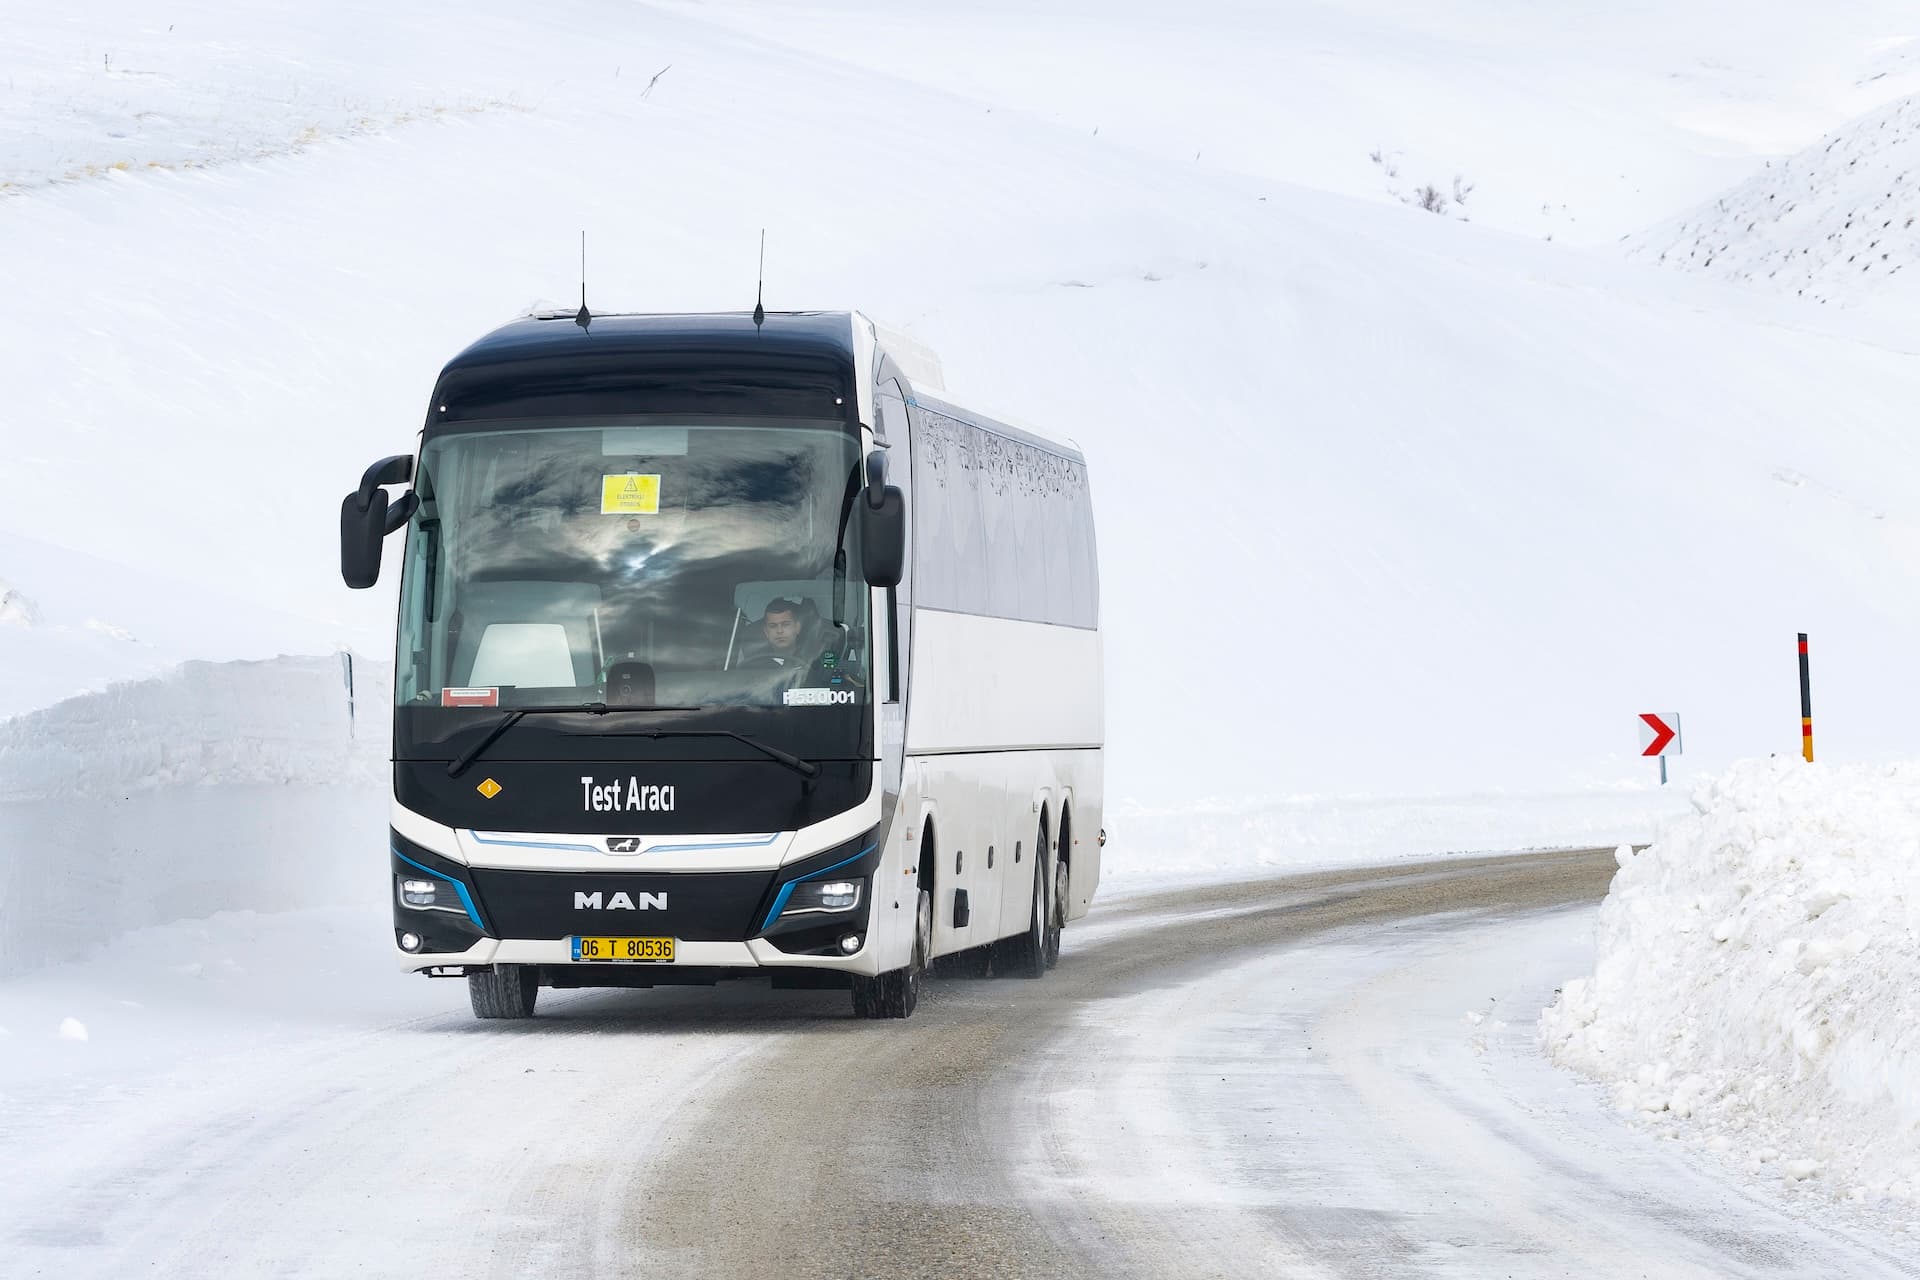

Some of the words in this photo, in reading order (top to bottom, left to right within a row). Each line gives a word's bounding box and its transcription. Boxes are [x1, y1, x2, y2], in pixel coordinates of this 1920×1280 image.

[581, 776, 621, 811] Test
[625, 776, 675, 811] Aracı
[574, 891, 668, 910] MAN
[581, 940, 599, 956] 06
[609, 940, 617, 956] T
[627, 940, 672, 957] 80536
